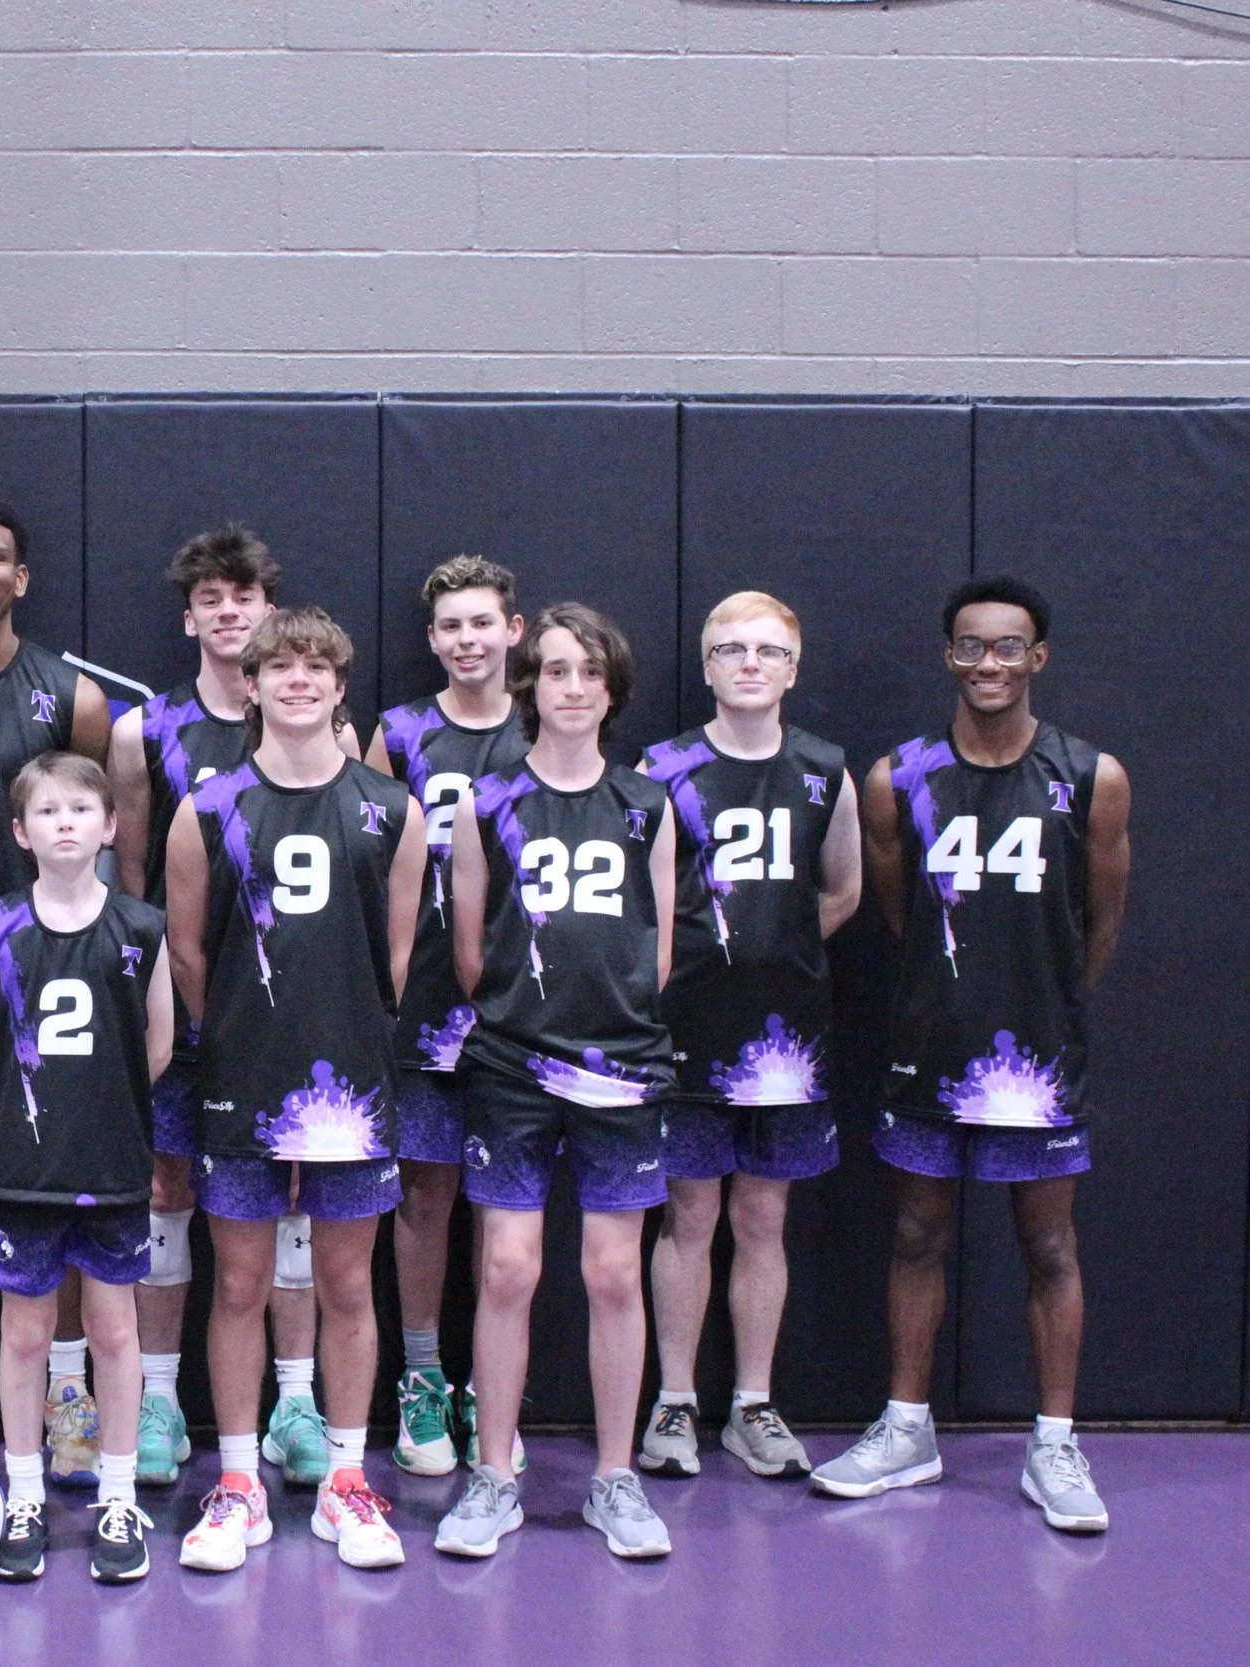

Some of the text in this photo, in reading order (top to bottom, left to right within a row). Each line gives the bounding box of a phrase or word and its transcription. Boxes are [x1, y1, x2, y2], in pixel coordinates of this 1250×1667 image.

[31, 689, 56, 723] T
[803, 773, 828, 806] T
[1049, 780, 1075, 814] T
[360, 800, 387, 836] T
[625, 808, 648, 841] T
[713, 807, 795, 882] 21
[926, 815, 1047, 893] 44
[272, 834, 331, 915] 9
[520, 836, 626, 917] 32
[122, 944, 143, 978] T
[38, 978, 94, 1056] 2
